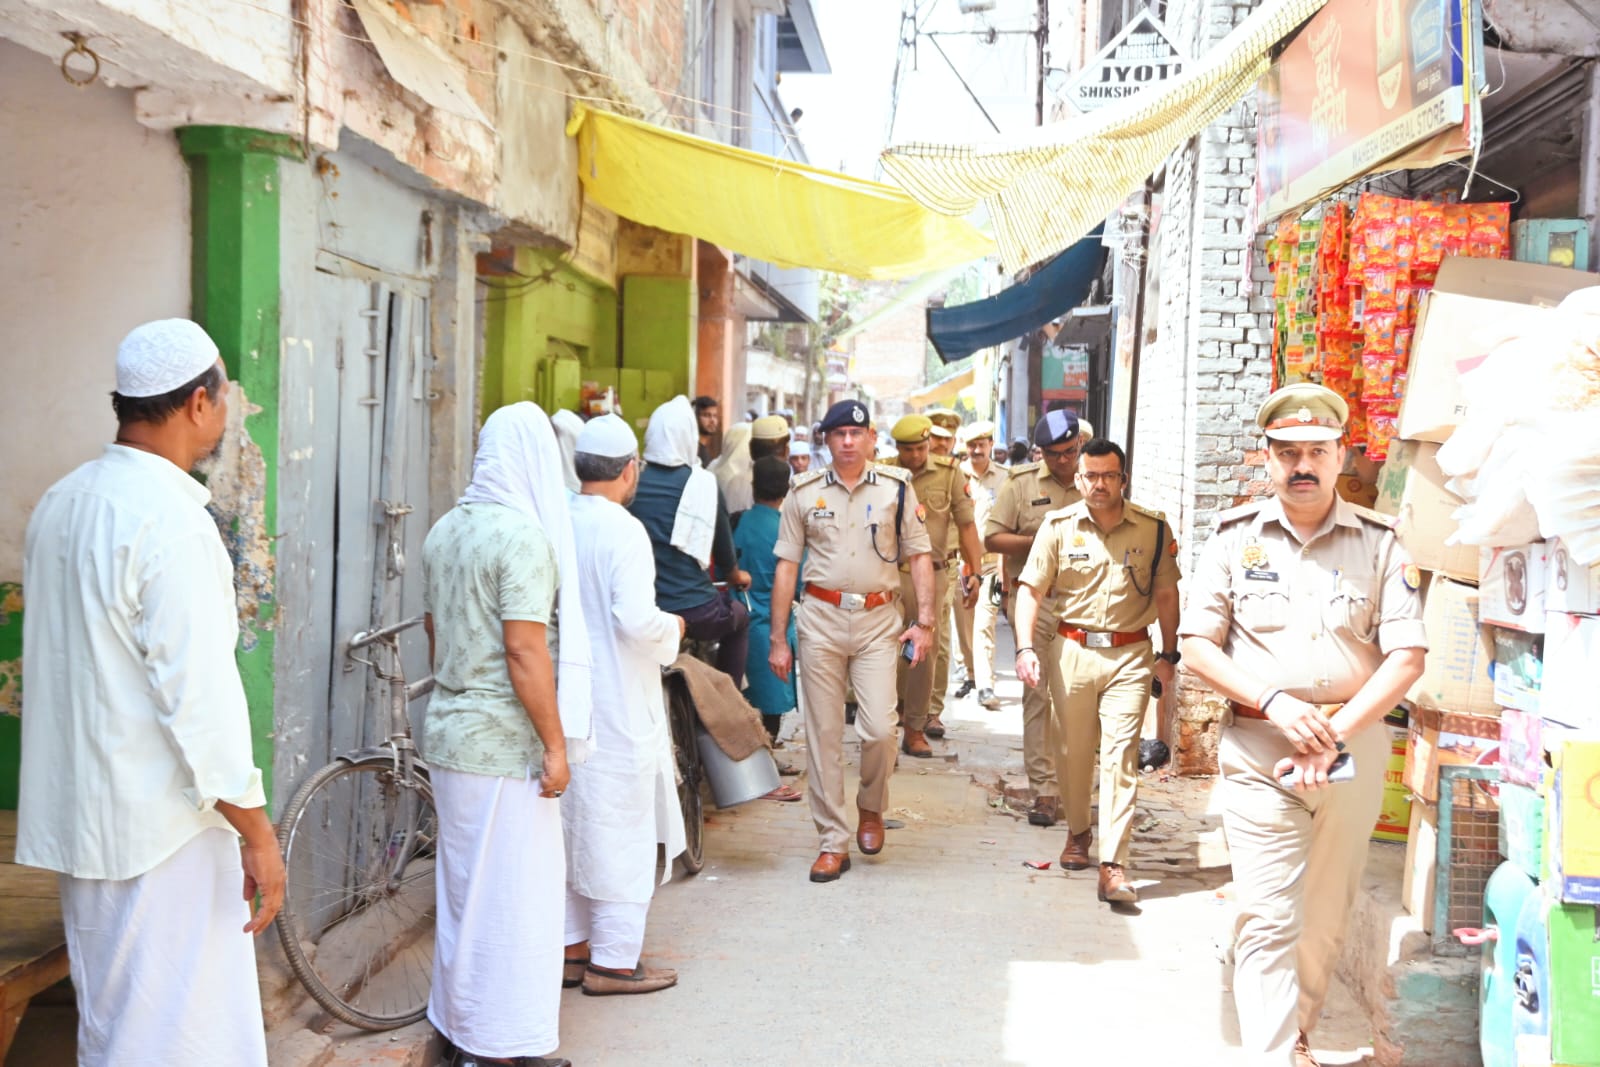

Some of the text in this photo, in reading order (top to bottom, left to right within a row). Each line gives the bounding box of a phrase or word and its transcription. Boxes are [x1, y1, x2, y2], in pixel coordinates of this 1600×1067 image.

[1099, 63, 1182, 82] JYOTI
[1380, 119, 1415, 153] GENERAL
[1416, 99, 1446, 134] STORE
